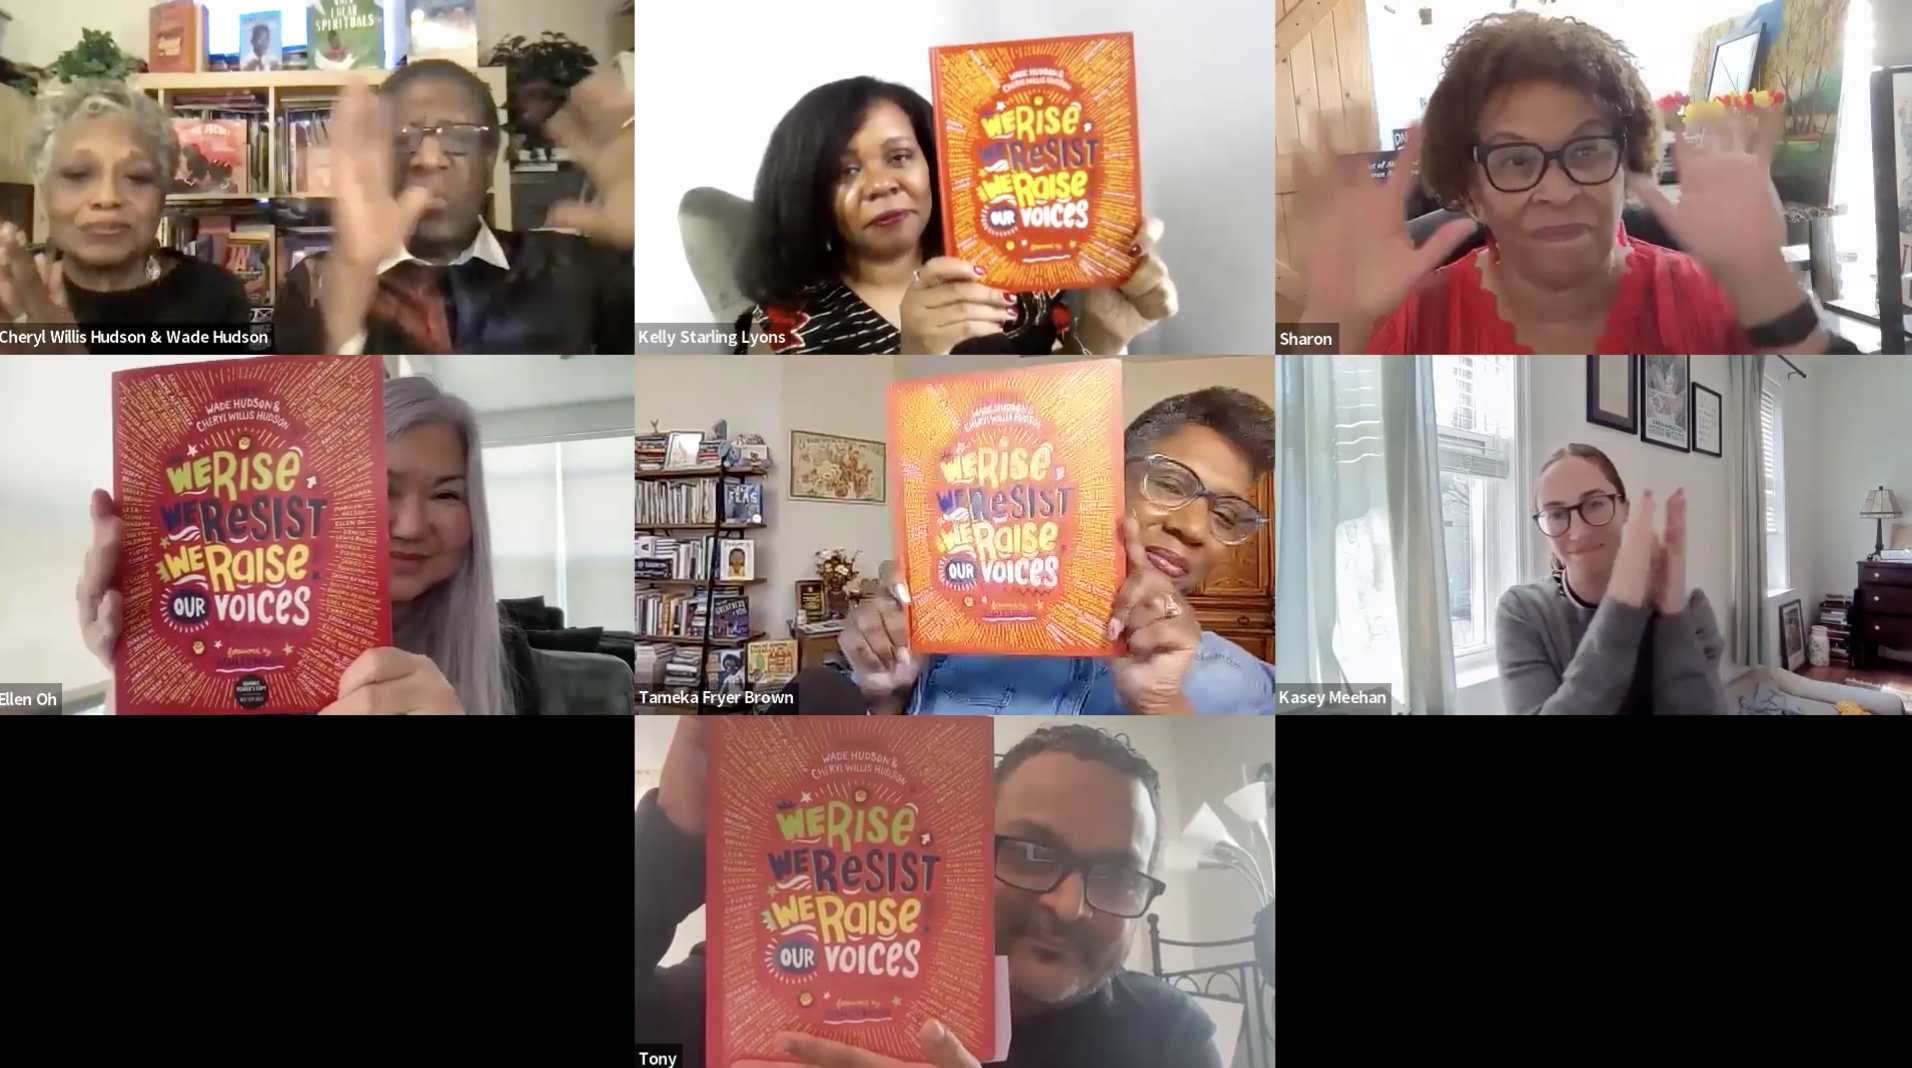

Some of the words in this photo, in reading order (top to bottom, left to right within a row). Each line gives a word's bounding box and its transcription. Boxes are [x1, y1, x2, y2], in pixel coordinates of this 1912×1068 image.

[315, 13, 374, 31] SPIRITUALS
[981, 110, 1016, 138] WE
[982, 174, 1013, 200] WE
[990, 210, 1016, 226] OUR
[205, 400, 231, 415] WADE
[233, 397, 273, 411] HUDSON
[273, 400, 281, 413] &
[196, 413, 228, 432] CHERYL
[228, 410, 255, 421] WILLIS
[256, 412, 291, 430] HUDSON
[165, 456, 212, 494] WE
[940, 451, 977, 483] WE
[159, 500, 199, 531] WE
[941, 522, 973, 550] WE
[164, 545, 205, 579] WE
[948, 562, 974, 579] OUR
[173, 596, 206, 618] OUR
[822, 751, 849, 763] WADE
[851, 751, 891, 765] HUDSON
[891, 757, 899, 769] &
[811, 764, 844, 780] CHERYL
[845, 764, 872, 773] WILLIS
[874, 765, 908, 786] HUDSON
[775, 805, 825, 841] WE
[767, 848, 809, 880] WE
[771, 895, 816, 929] WE
[780, 947, 815, 968] OUR
